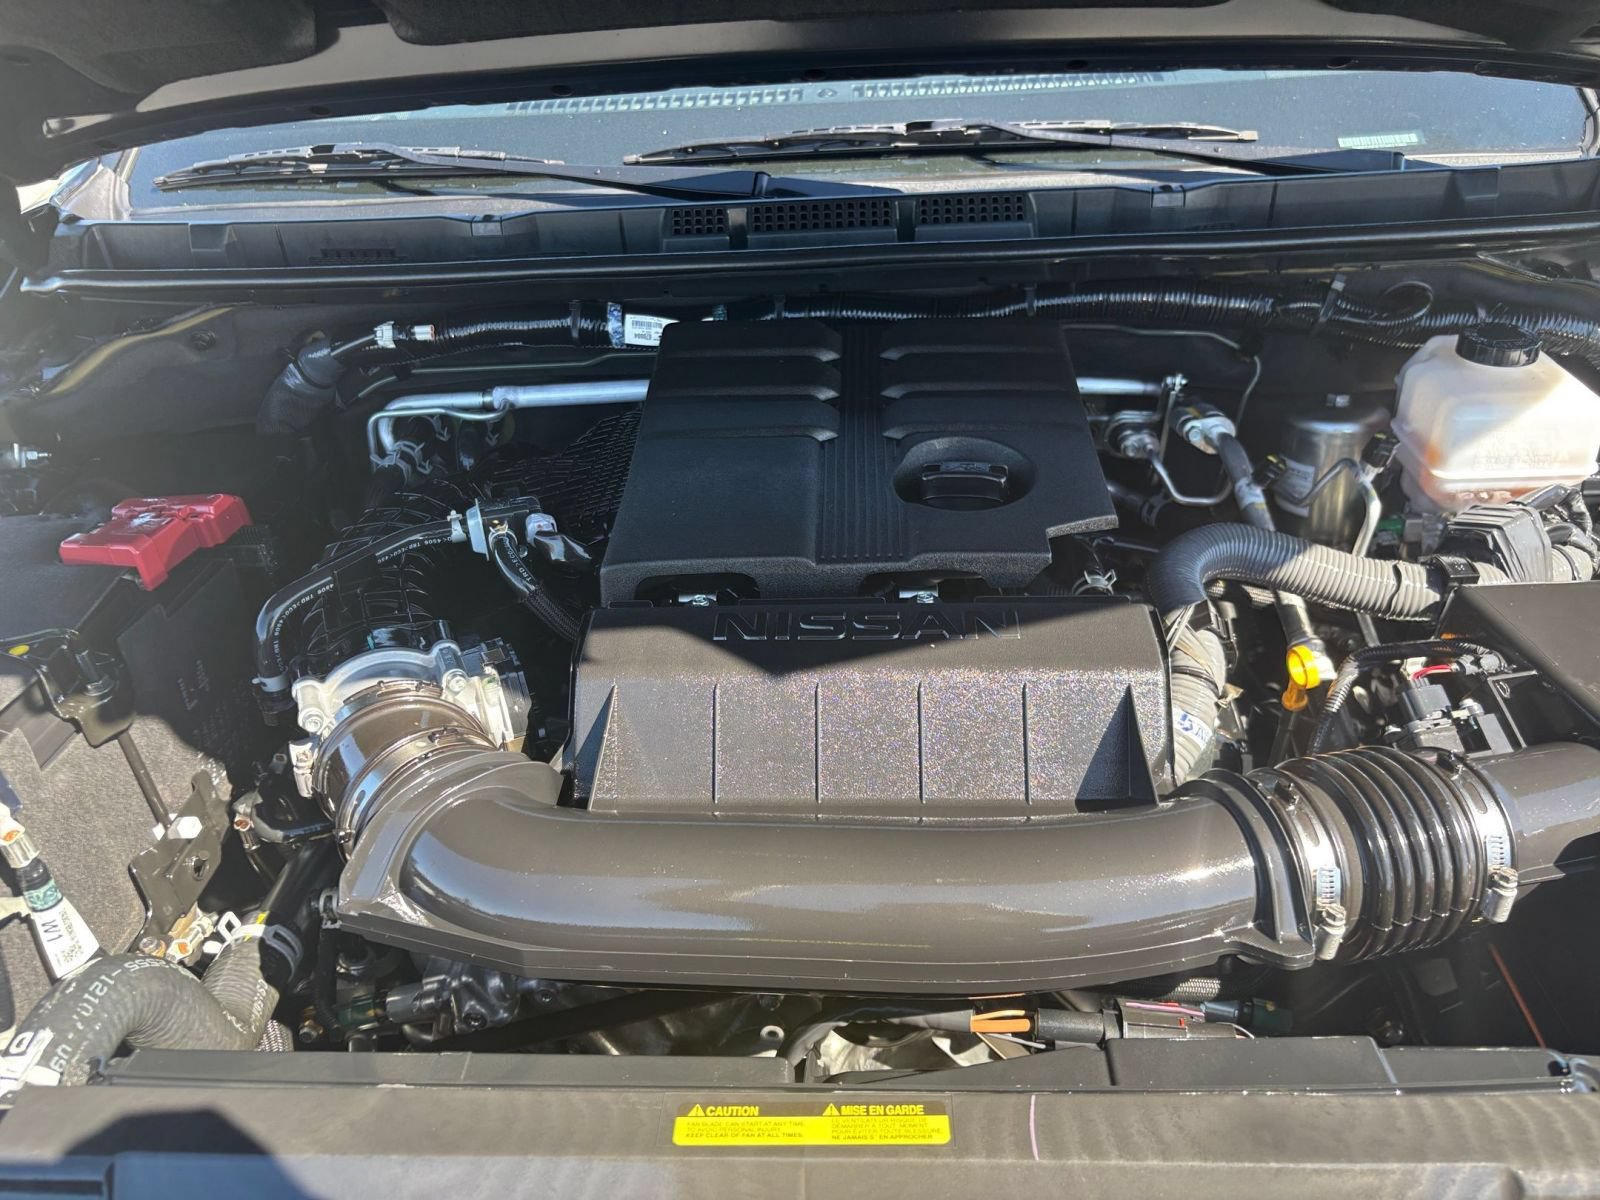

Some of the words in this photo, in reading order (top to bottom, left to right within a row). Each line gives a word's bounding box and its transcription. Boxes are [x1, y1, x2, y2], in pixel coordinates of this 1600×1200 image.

[713, 610, 1021, 640] NISSAN
[706, 1105, 759, 1116] CAUTION
[841, 1104, 867, 1115] MISE
[868, 1104, 885, 1115] EN
[886, 1104, 925, 1115] GARDE
